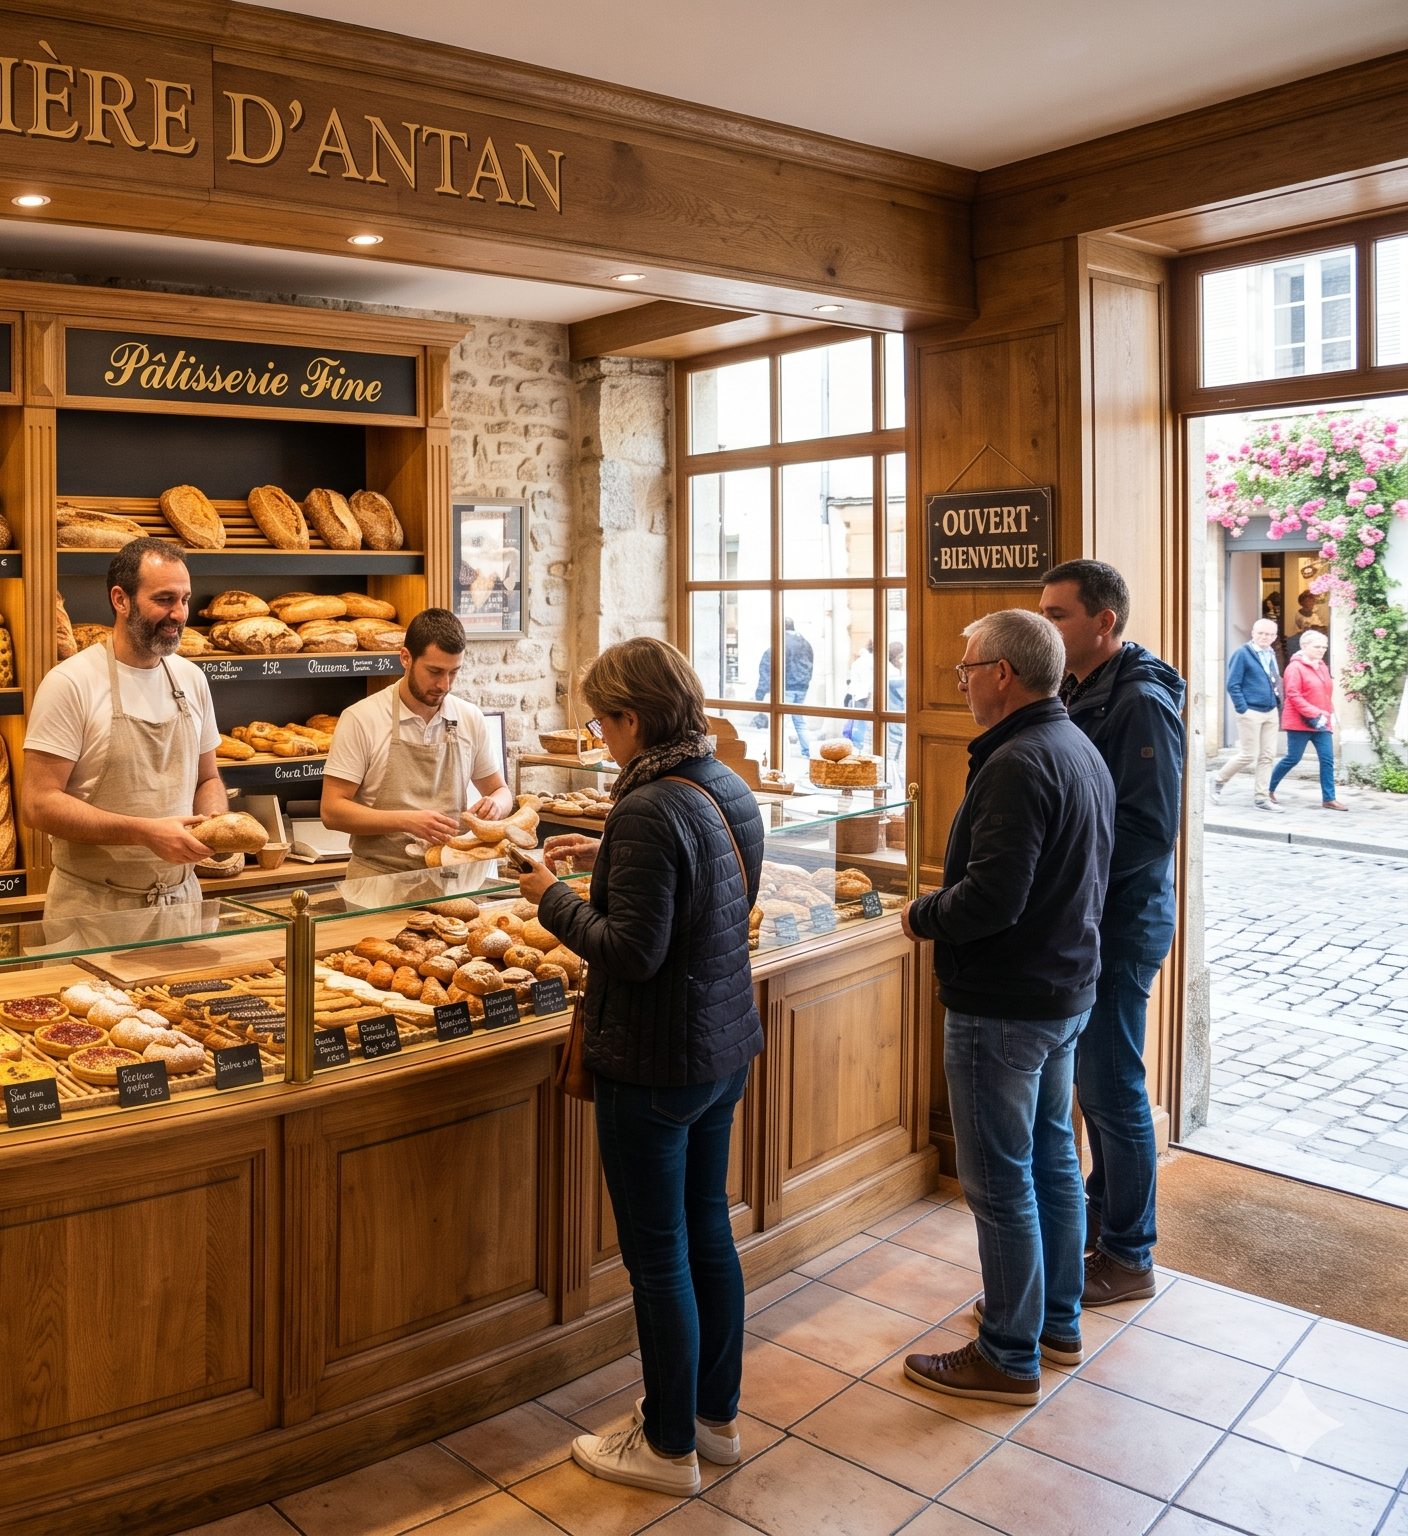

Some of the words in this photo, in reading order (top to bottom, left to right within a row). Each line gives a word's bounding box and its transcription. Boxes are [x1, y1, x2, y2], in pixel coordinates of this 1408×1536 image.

[104, 341, 289, 397] Pâtisserie
[300, 356, 382, 403] Fine
[942, 505, 1031, 537] OUVERT
[940, 544, 1039, 570] BIENVENUE
